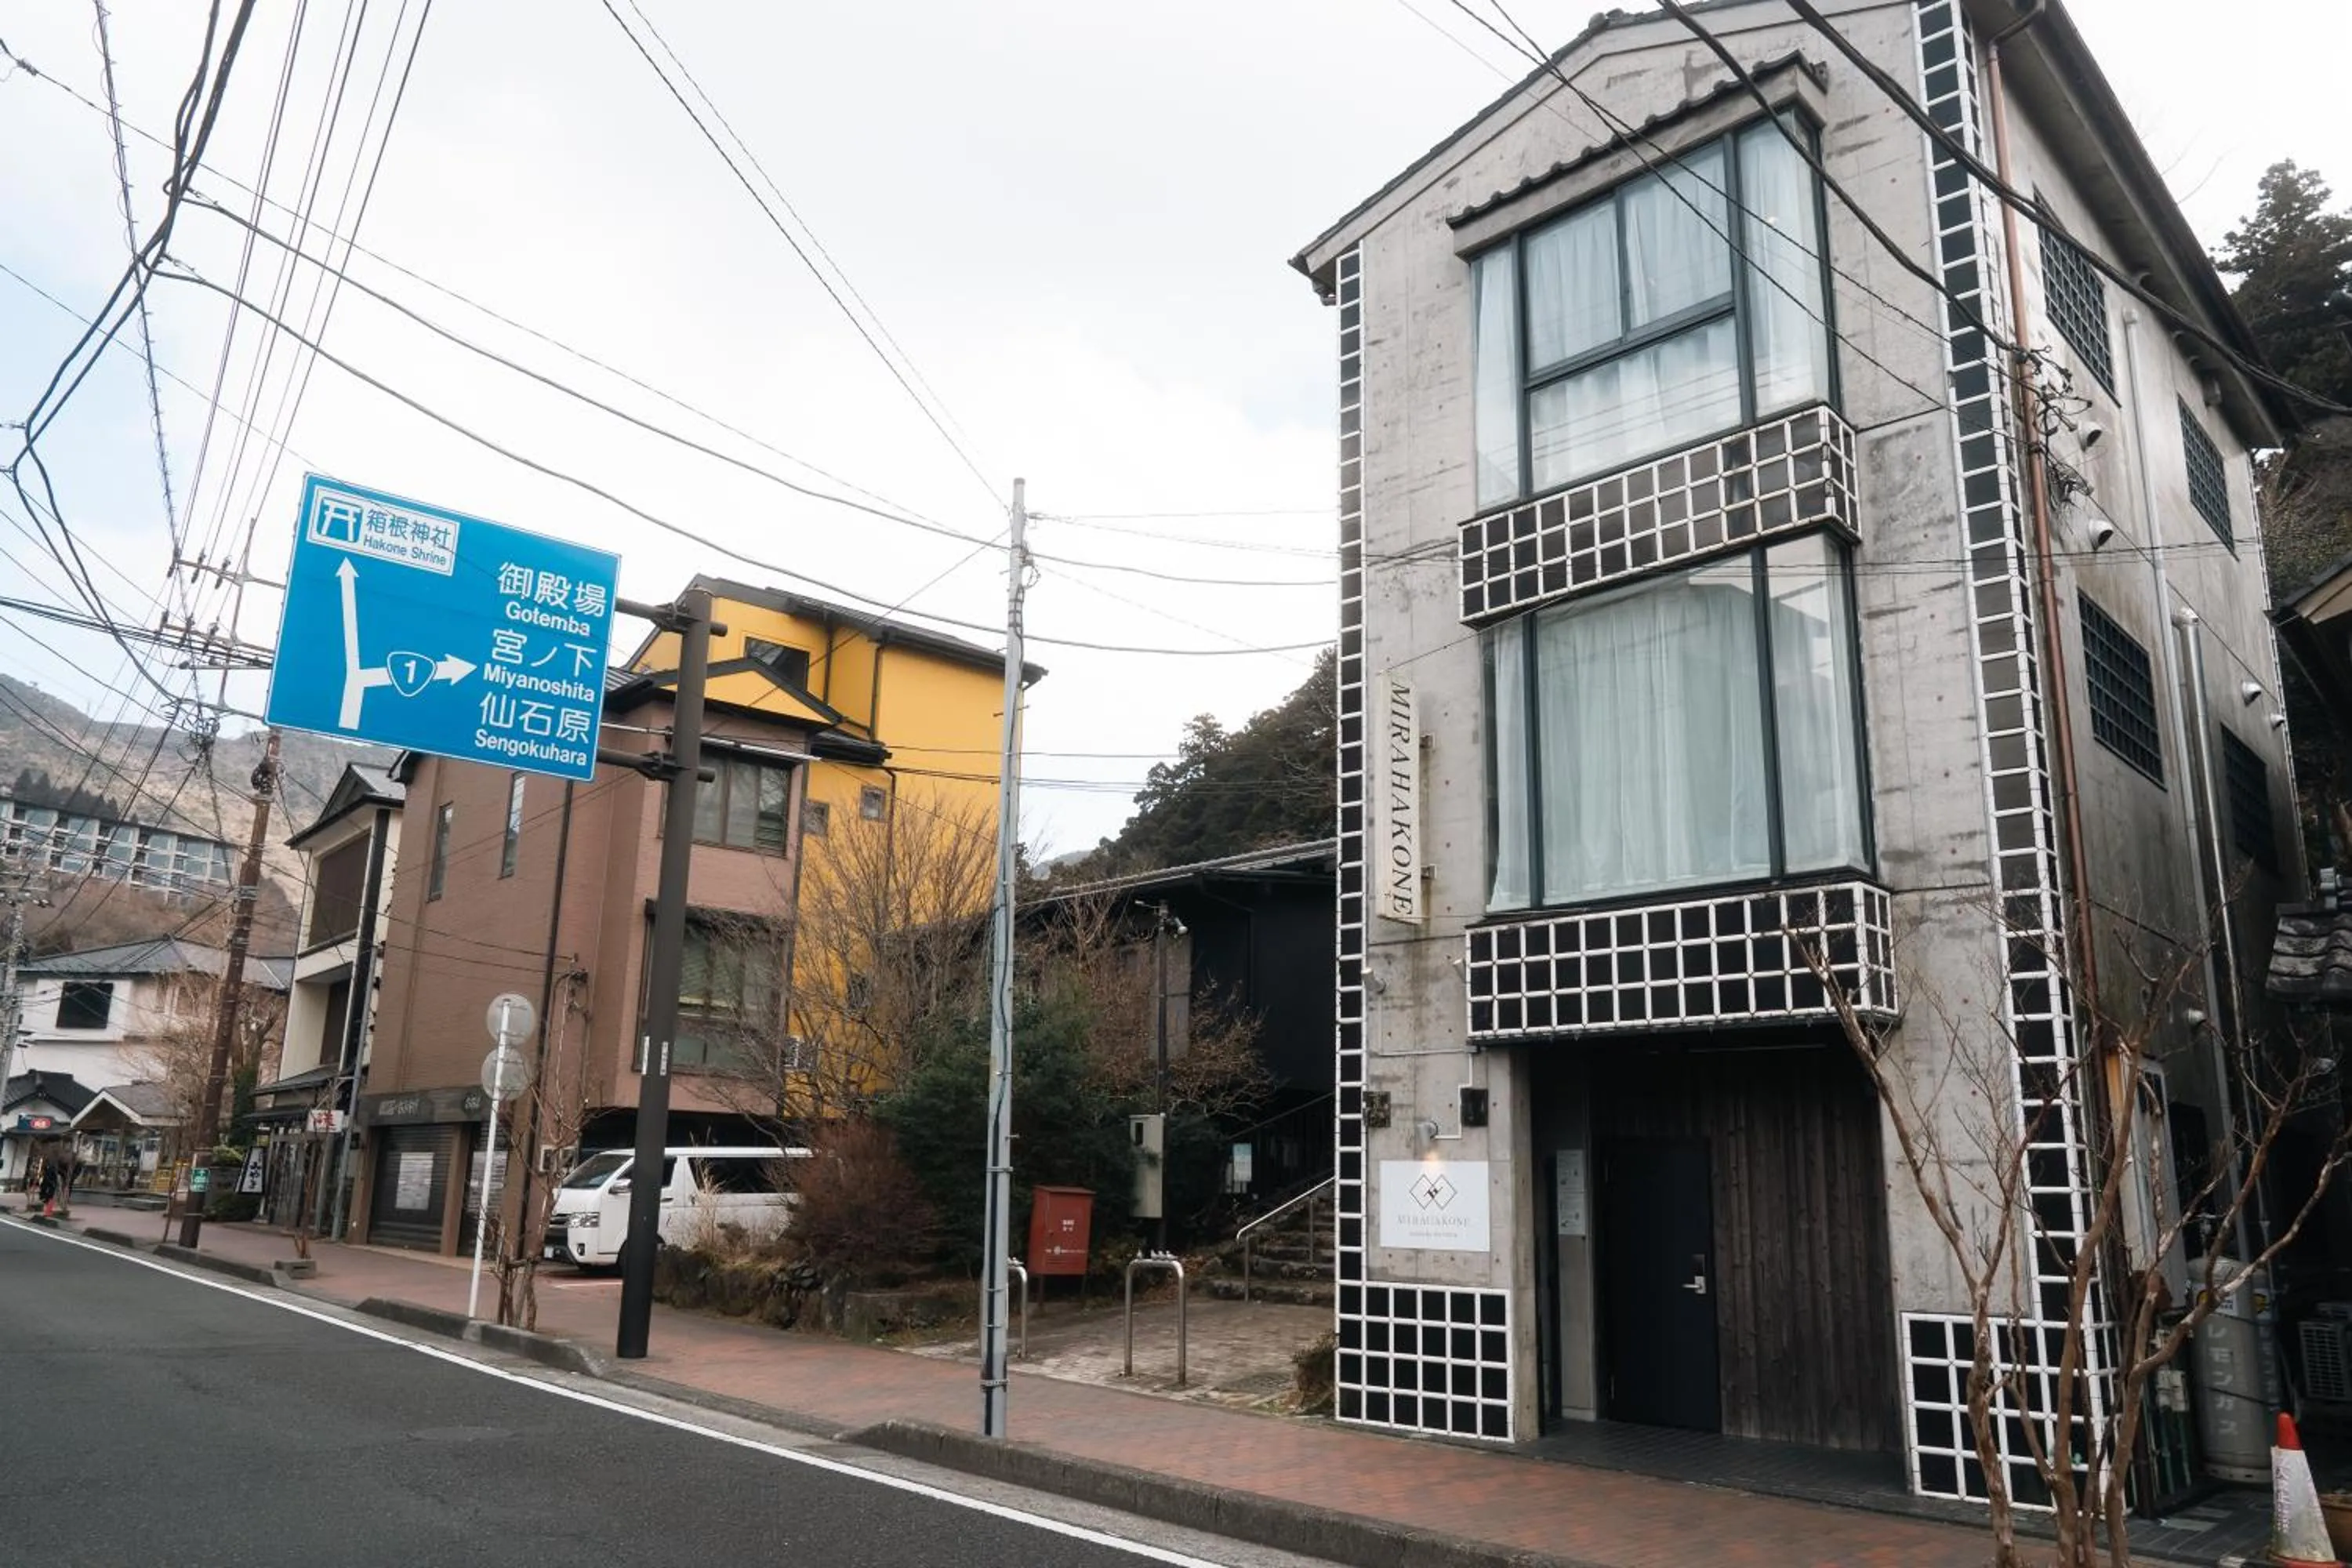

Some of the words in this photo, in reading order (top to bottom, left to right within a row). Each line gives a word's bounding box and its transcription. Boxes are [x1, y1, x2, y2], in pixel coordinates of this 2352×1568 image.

[365, 507, 452, 549] 箱根神社
[363, 536, 408, 557] Hakone
[411, 546, 447, 566] Shrine
[497, 561, 608, 618] 御殿場
[506, 601, 591, 637] Gotemba
[405, 659, 416, 684] 1
[492, 628, 598, 678] 宮ノ下
[483, 662, 595, 703] Miyanoshita
[478, 690, 593, 745] 仙石原
[474, 730, 587, 767] Sengokuhara
[1391, 681, 1412, 916] MIRAHAKONE
